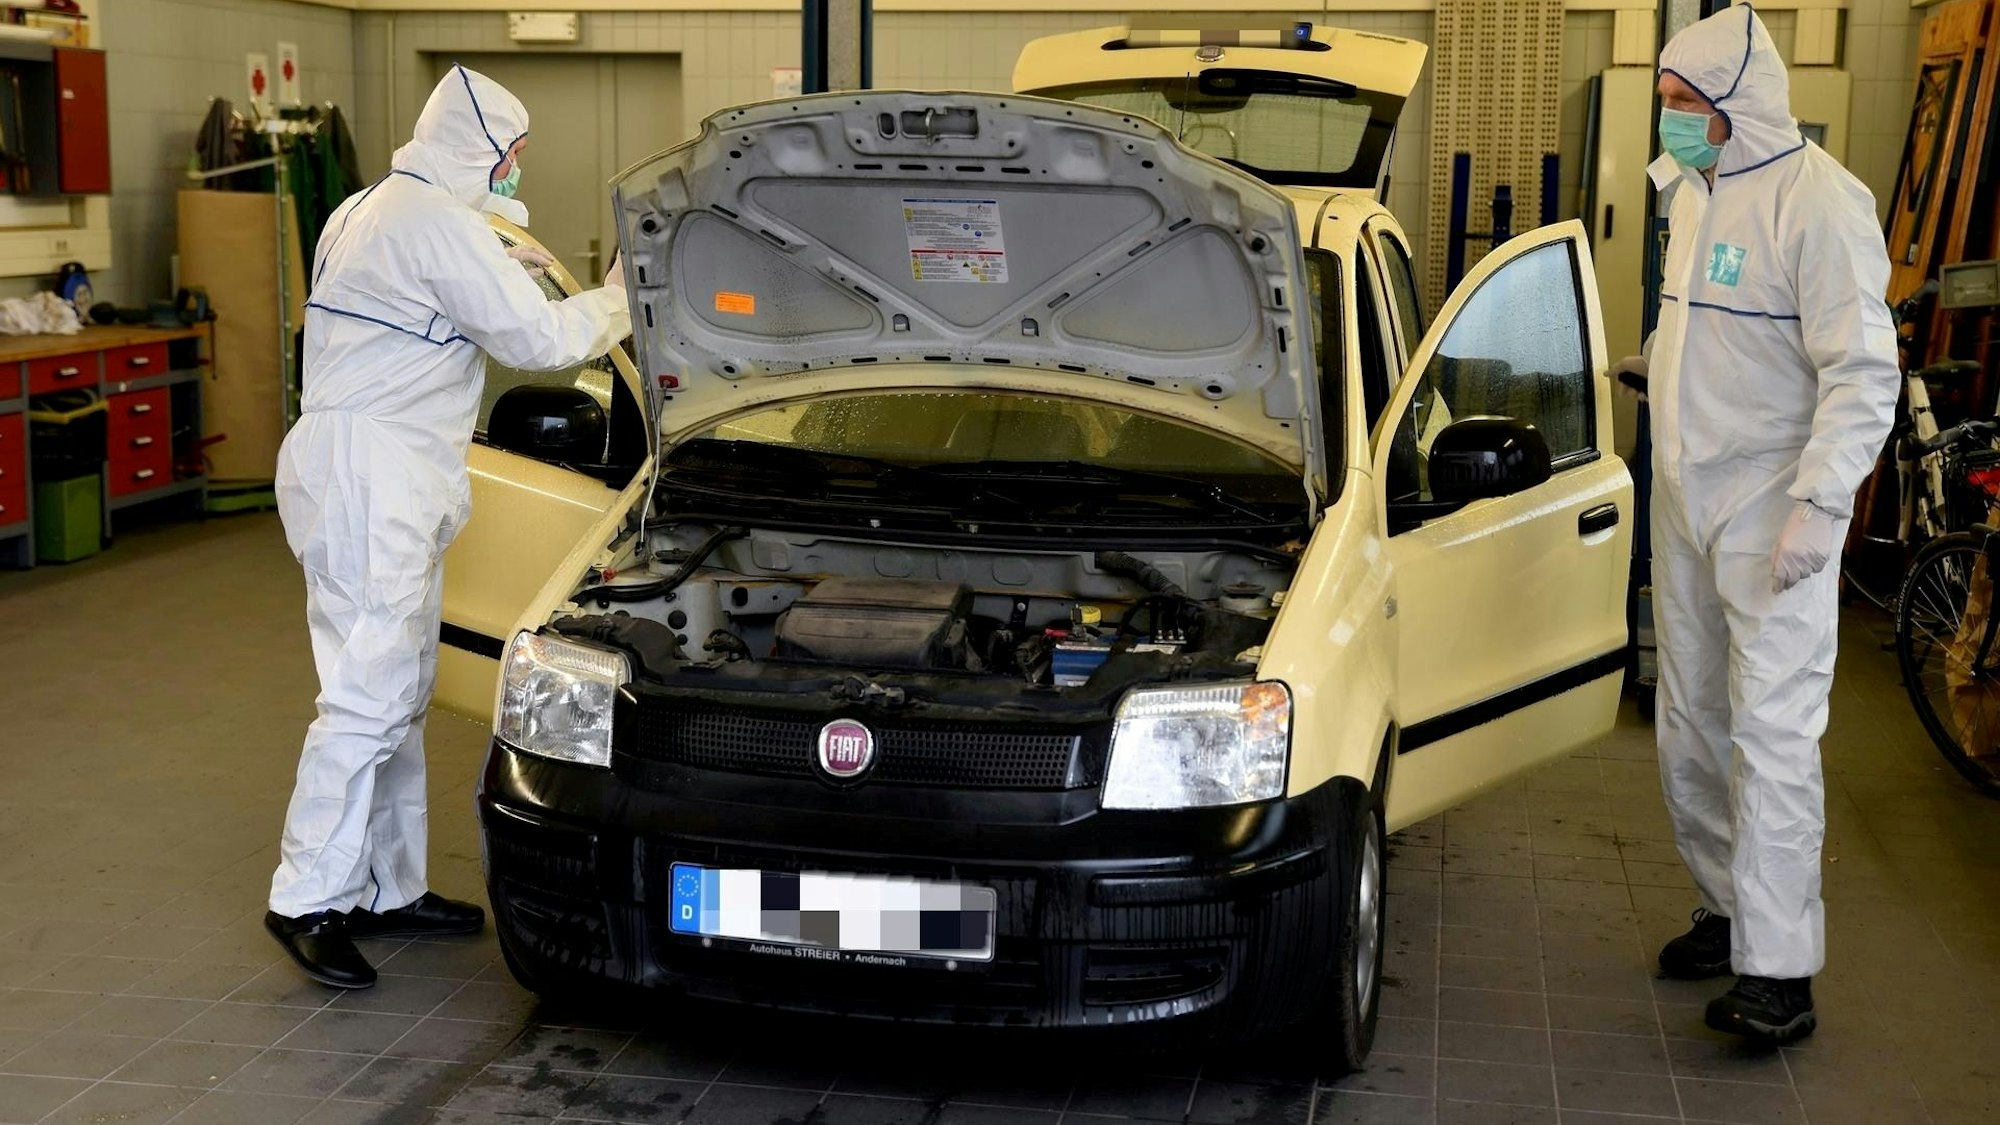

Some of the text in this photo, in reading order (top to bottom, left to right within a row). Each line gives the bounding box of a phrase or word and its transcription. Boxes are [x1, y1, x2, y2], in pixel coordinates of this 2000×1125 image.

[829, 735, 862, 763] FIAT
[682, 904, 693, 920] D
[750, 943, 906, 967] Autohaus STREIER Andernach
